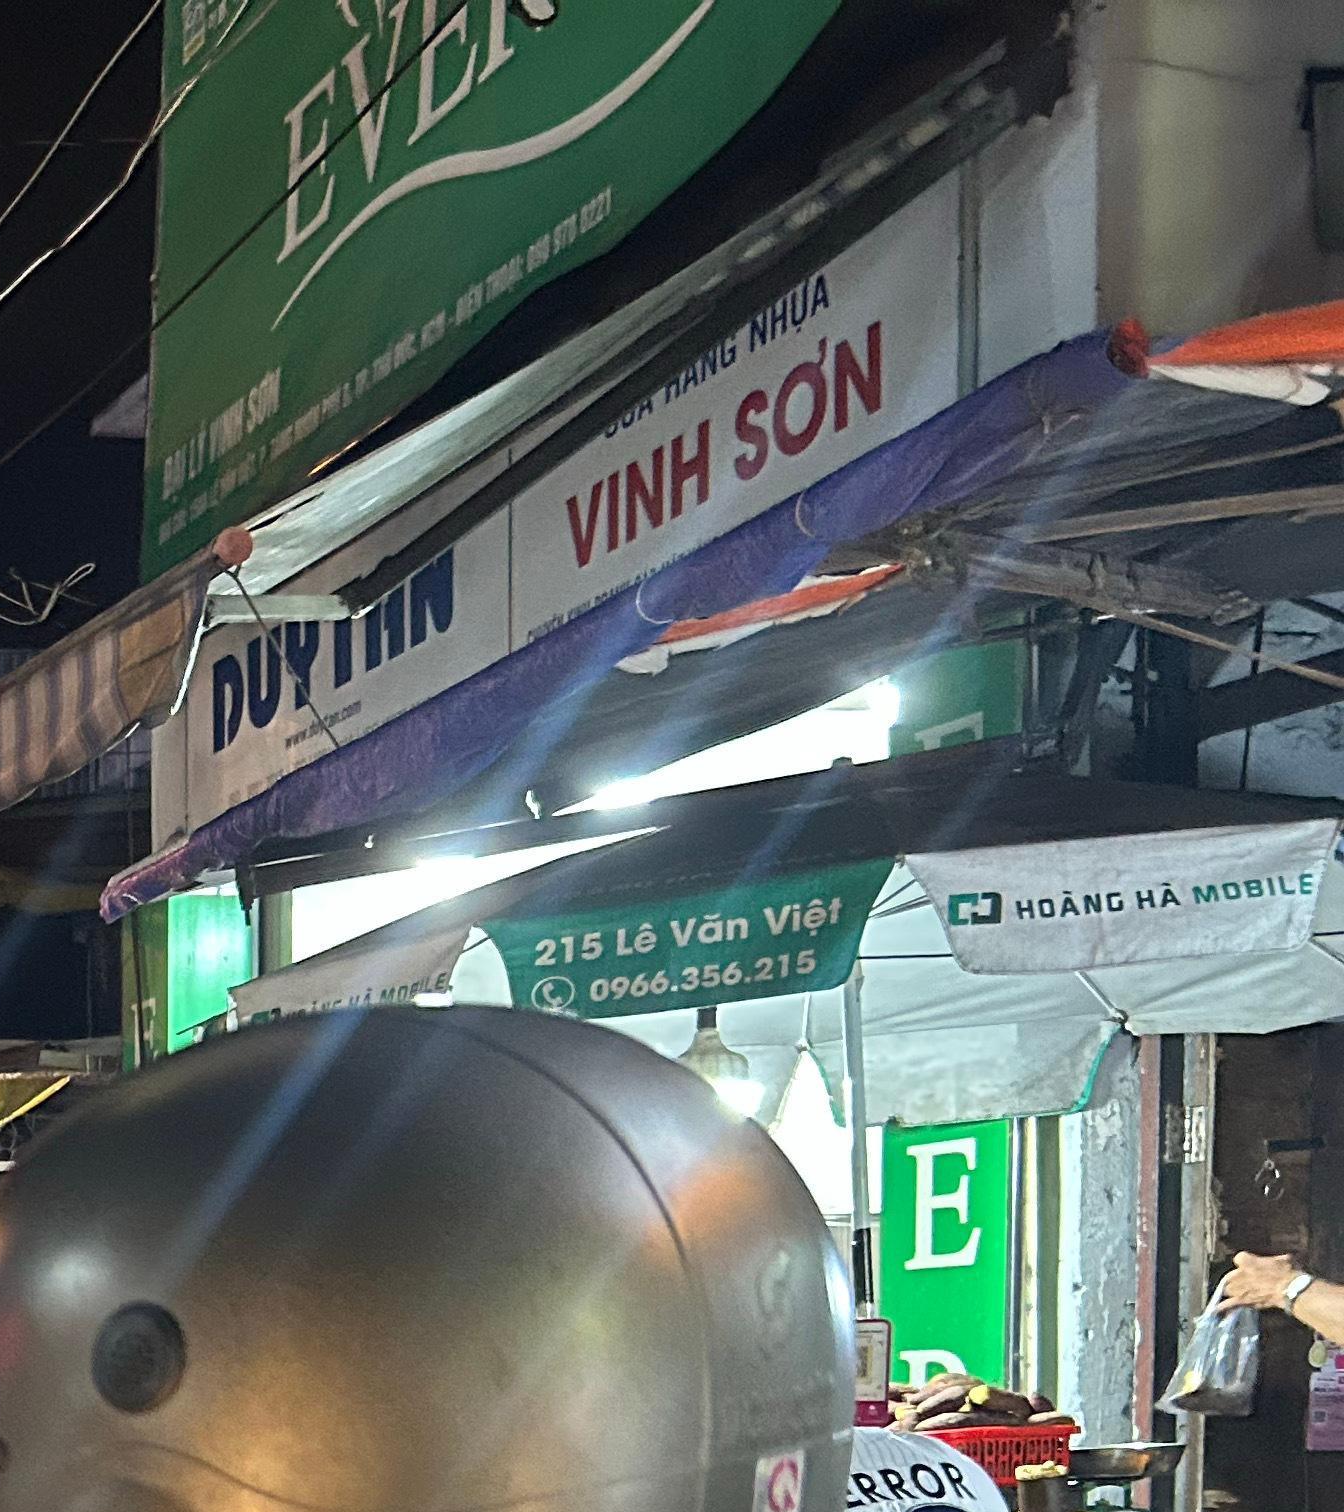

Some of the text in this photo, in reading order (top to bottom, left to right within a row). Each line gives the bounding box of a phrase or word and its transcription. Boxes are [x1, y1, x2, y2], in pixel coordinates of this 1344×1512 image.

[565, 320, 883, 570] VINH SƠN
[533, 896, 843, 968] 215 Lê Văn Việt
[1014, 872, 1315, 922] HOÀNG HÀ MOBILE
[588, 949, 818, 1003] 0966.356.215
[903, 1136, 984, 1272] E
